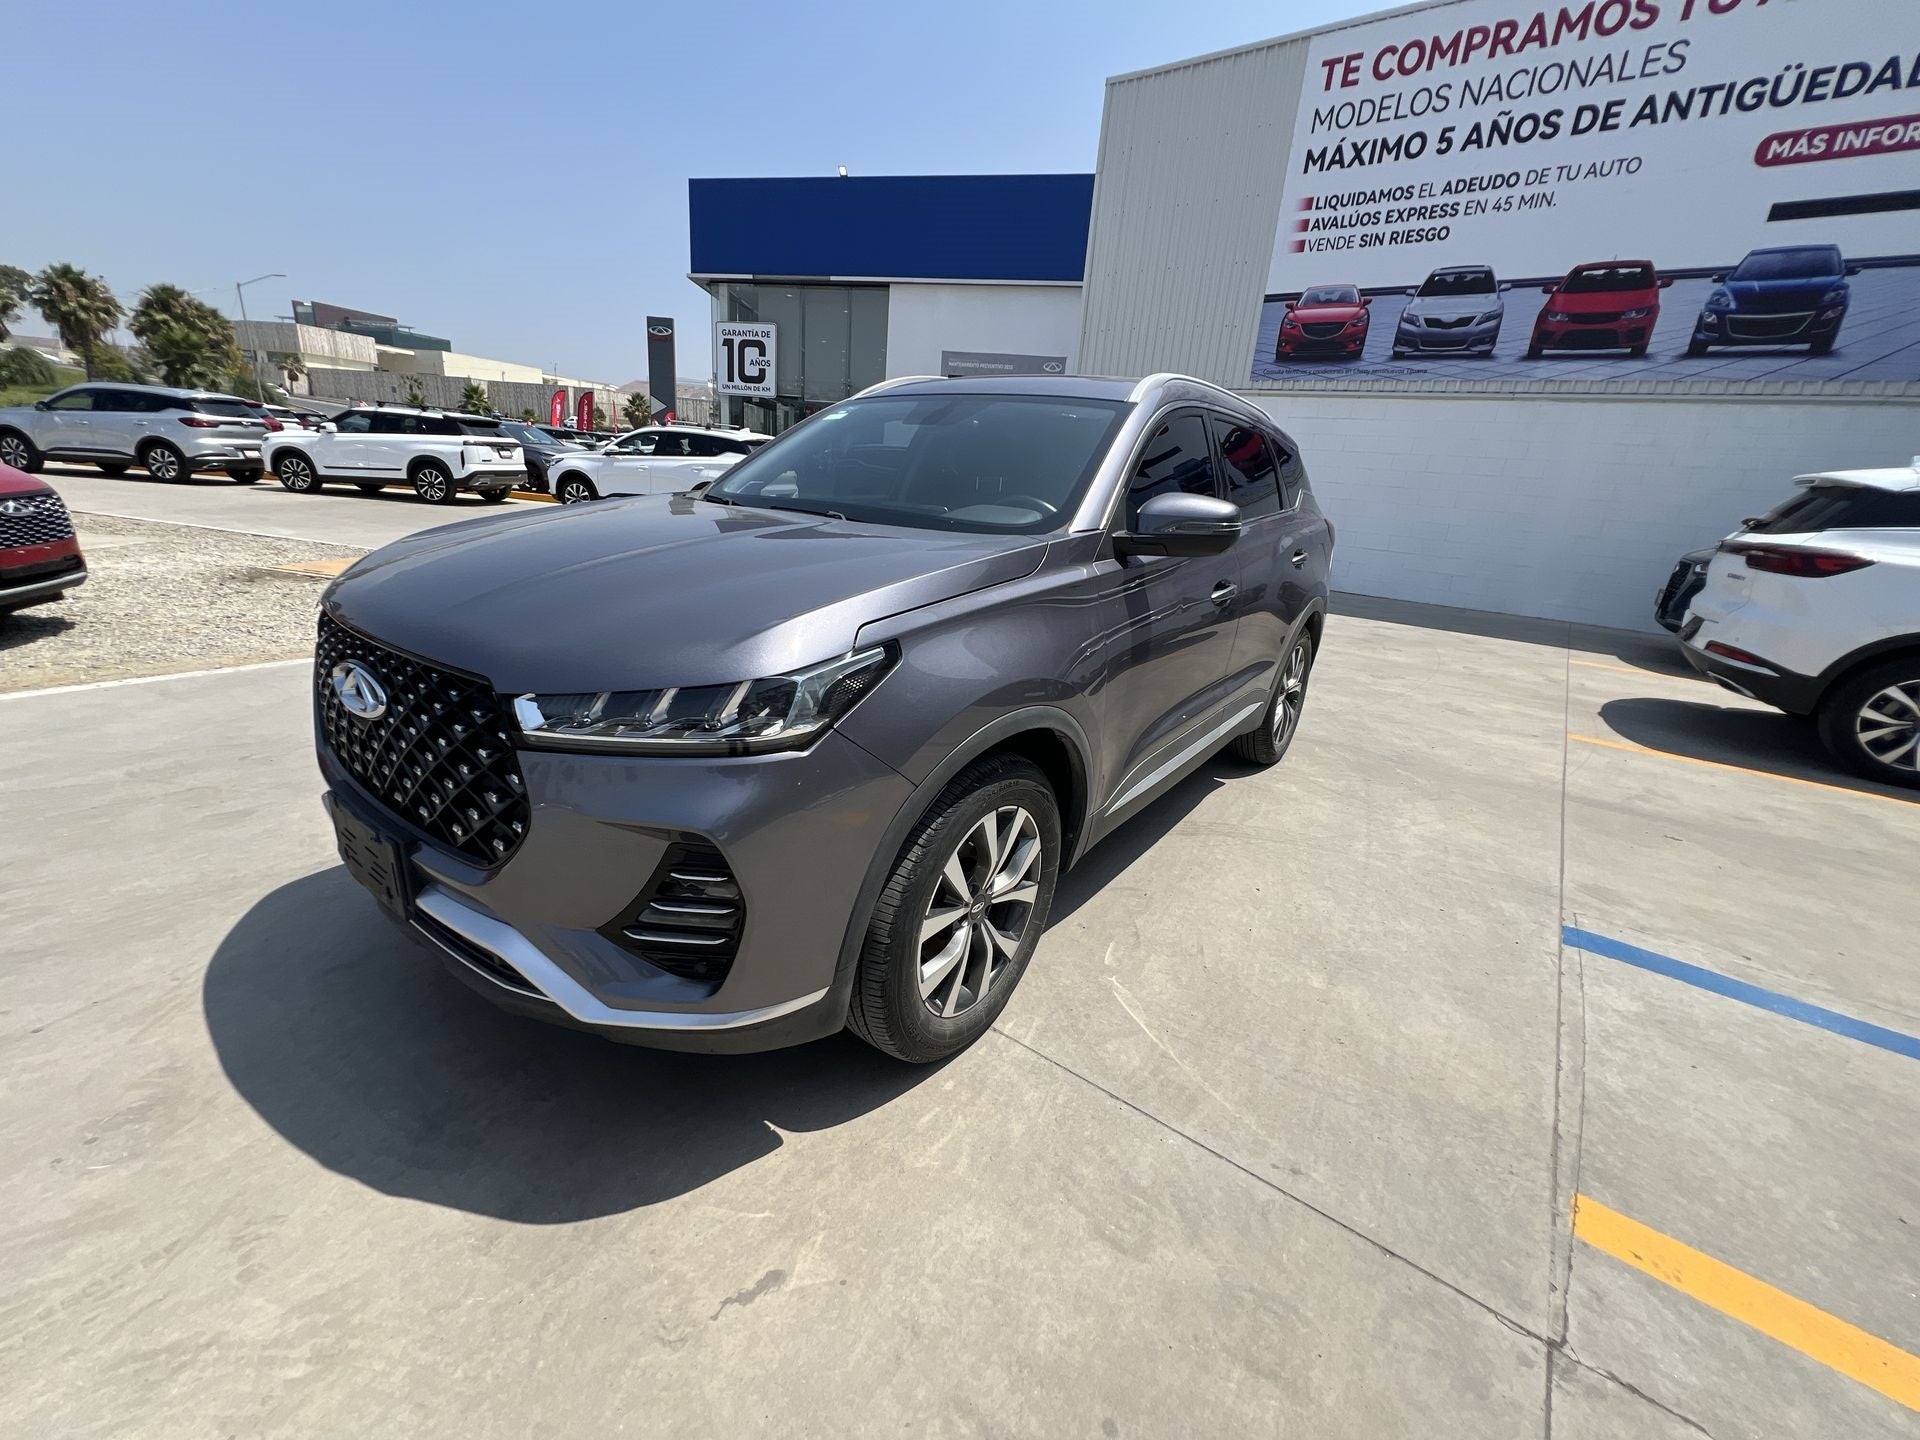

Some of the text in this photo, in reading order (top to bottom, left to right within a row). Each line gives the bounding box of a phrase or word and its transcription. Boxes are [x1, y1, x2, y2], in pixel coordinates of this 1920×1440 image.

[1321, 52, 1364, 91] TE
[1372, 0, 1660, 81] COMPRAMOS
[1311, 39, 1690, 133] MODELOS NACIONALES
[1303, 131, 1428, 174] MÁXIMO
[1435, 126, 1456, 155] 5
[1460, 109, 1564, 151] AÑOS
[1570, 99, 1626, 136] DE
[1767, 130, 1827, 160] MÁS
[1315, 156, 1642, 211] LIQUIDAMOS EL ADEUDO DE TU AUTO
[1311, 191, 1557, 232] AVALÚOS EXPRESS EN 45 MIN.
[1308, 226, 1450, 252] VENDE SIN RIESGO
[722, 328, 771, 338] GARANTÍA DE
[722, 338, 766, 384] 10
[750, 357, 771, 367] AÑOS
